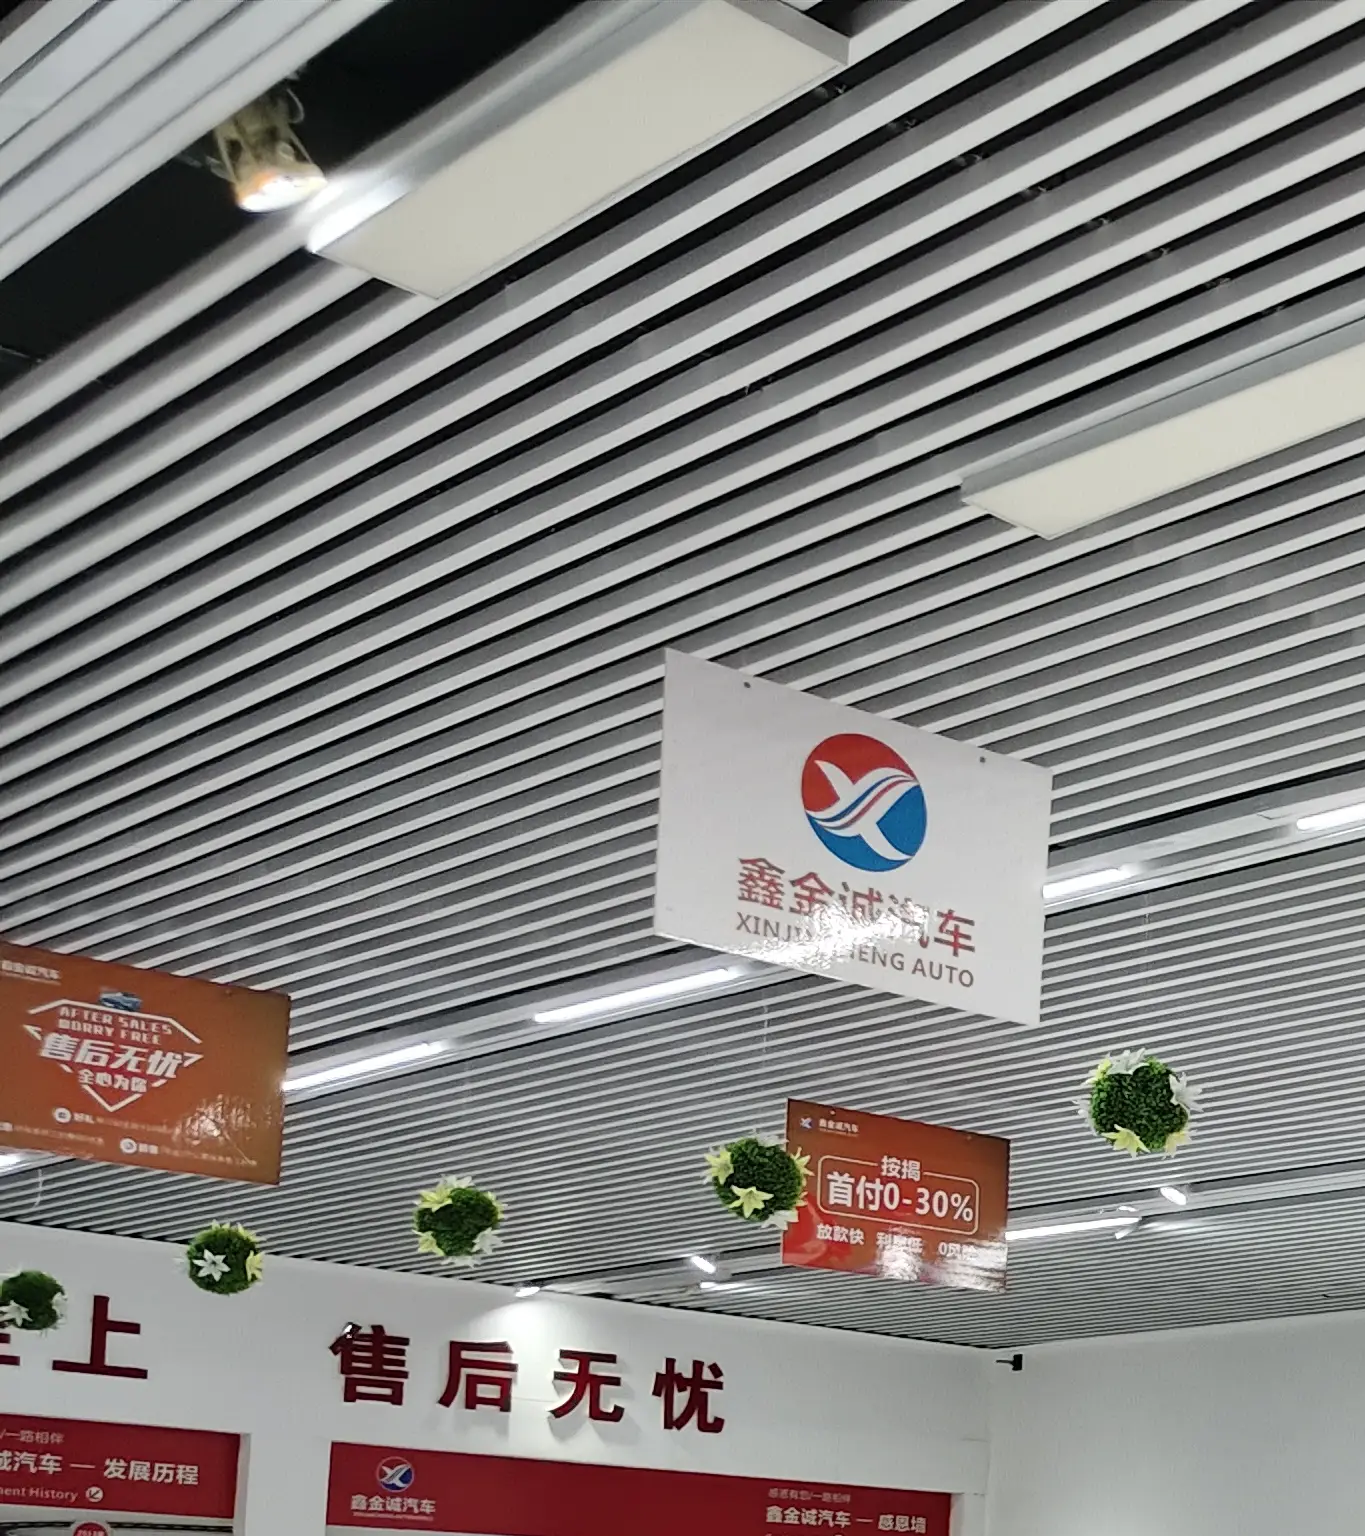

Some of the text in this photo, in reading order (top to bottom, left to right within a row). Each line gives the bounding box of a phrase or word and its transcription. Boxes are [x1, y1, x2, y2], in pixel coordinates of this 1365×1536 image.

[737, 857, 977, 958] 鑫金诚汽车
[911, 957, 975, 988] AUTO
[60, 1006, 172, 1035] AFTER SALES
[120, 1028, 161, 1045] FREE
[40, 1032, 184, 1078] 售后无忧
[77, 1068, 148, 1093] 全心为你
[880, 1155, 922, 1181] 按揭
[826, 1171, 975, 1222] 首付0-30%
[816, 1223, 865, 1245] 放款快
[329, 1323, 726, 1434] 售后无忧
[103, 1458, 200, 1485] 发展历程
[29, 1486, 79, 1503] History
[350, 1494, 437, 1514] 鑫金诚汽车
[765, 1505, 928, 1534] 鑫金诚汽车 感恩墙
